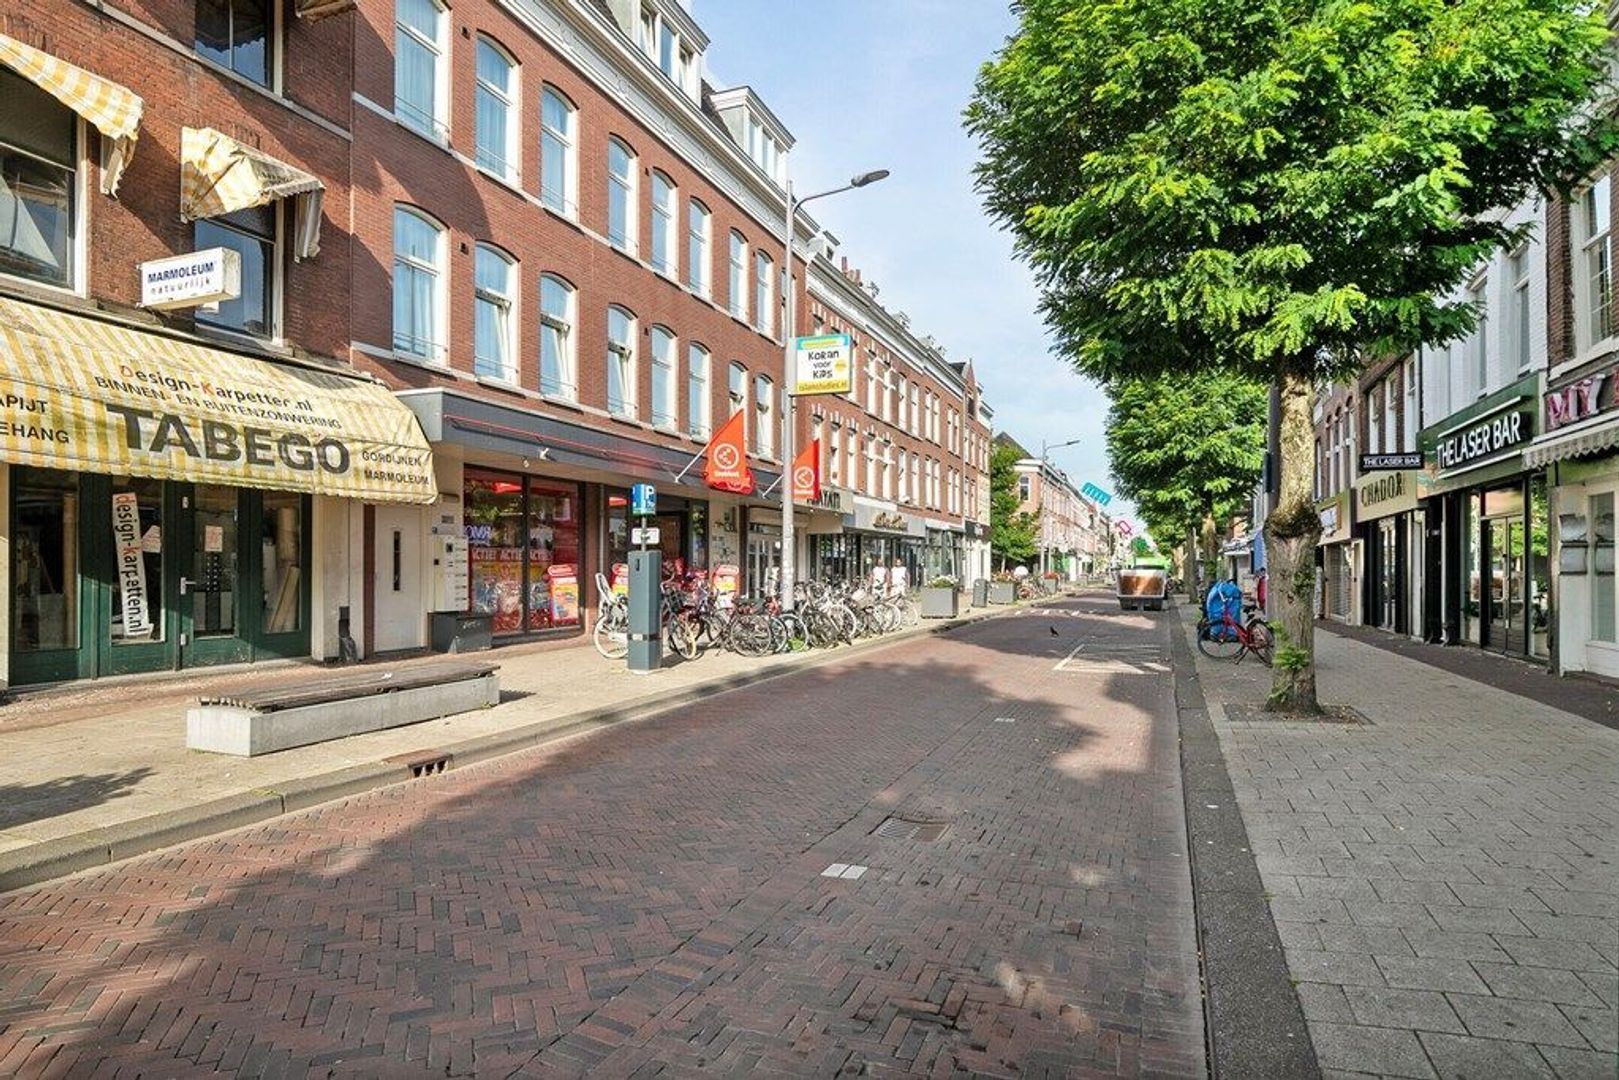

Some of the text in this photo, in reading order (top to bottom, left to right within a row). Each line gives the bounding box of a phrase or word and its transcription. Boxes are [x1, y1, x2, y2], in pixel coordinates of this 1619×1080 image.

[148, 261, 214, 283] MARMOLEUM
[151, 277, 210, 295] natuurlijk
[176, 393, 200, 407] EN
[203, 399, 342, 429] BUITENZONWERING
[106, 403, 351, 474] TABEGO
[1493, 411, 1521, 450] BAR
[364, 470, 429, 485] MARMOLEUM
[115, 494, 147, 633] design-karpetten.nl
